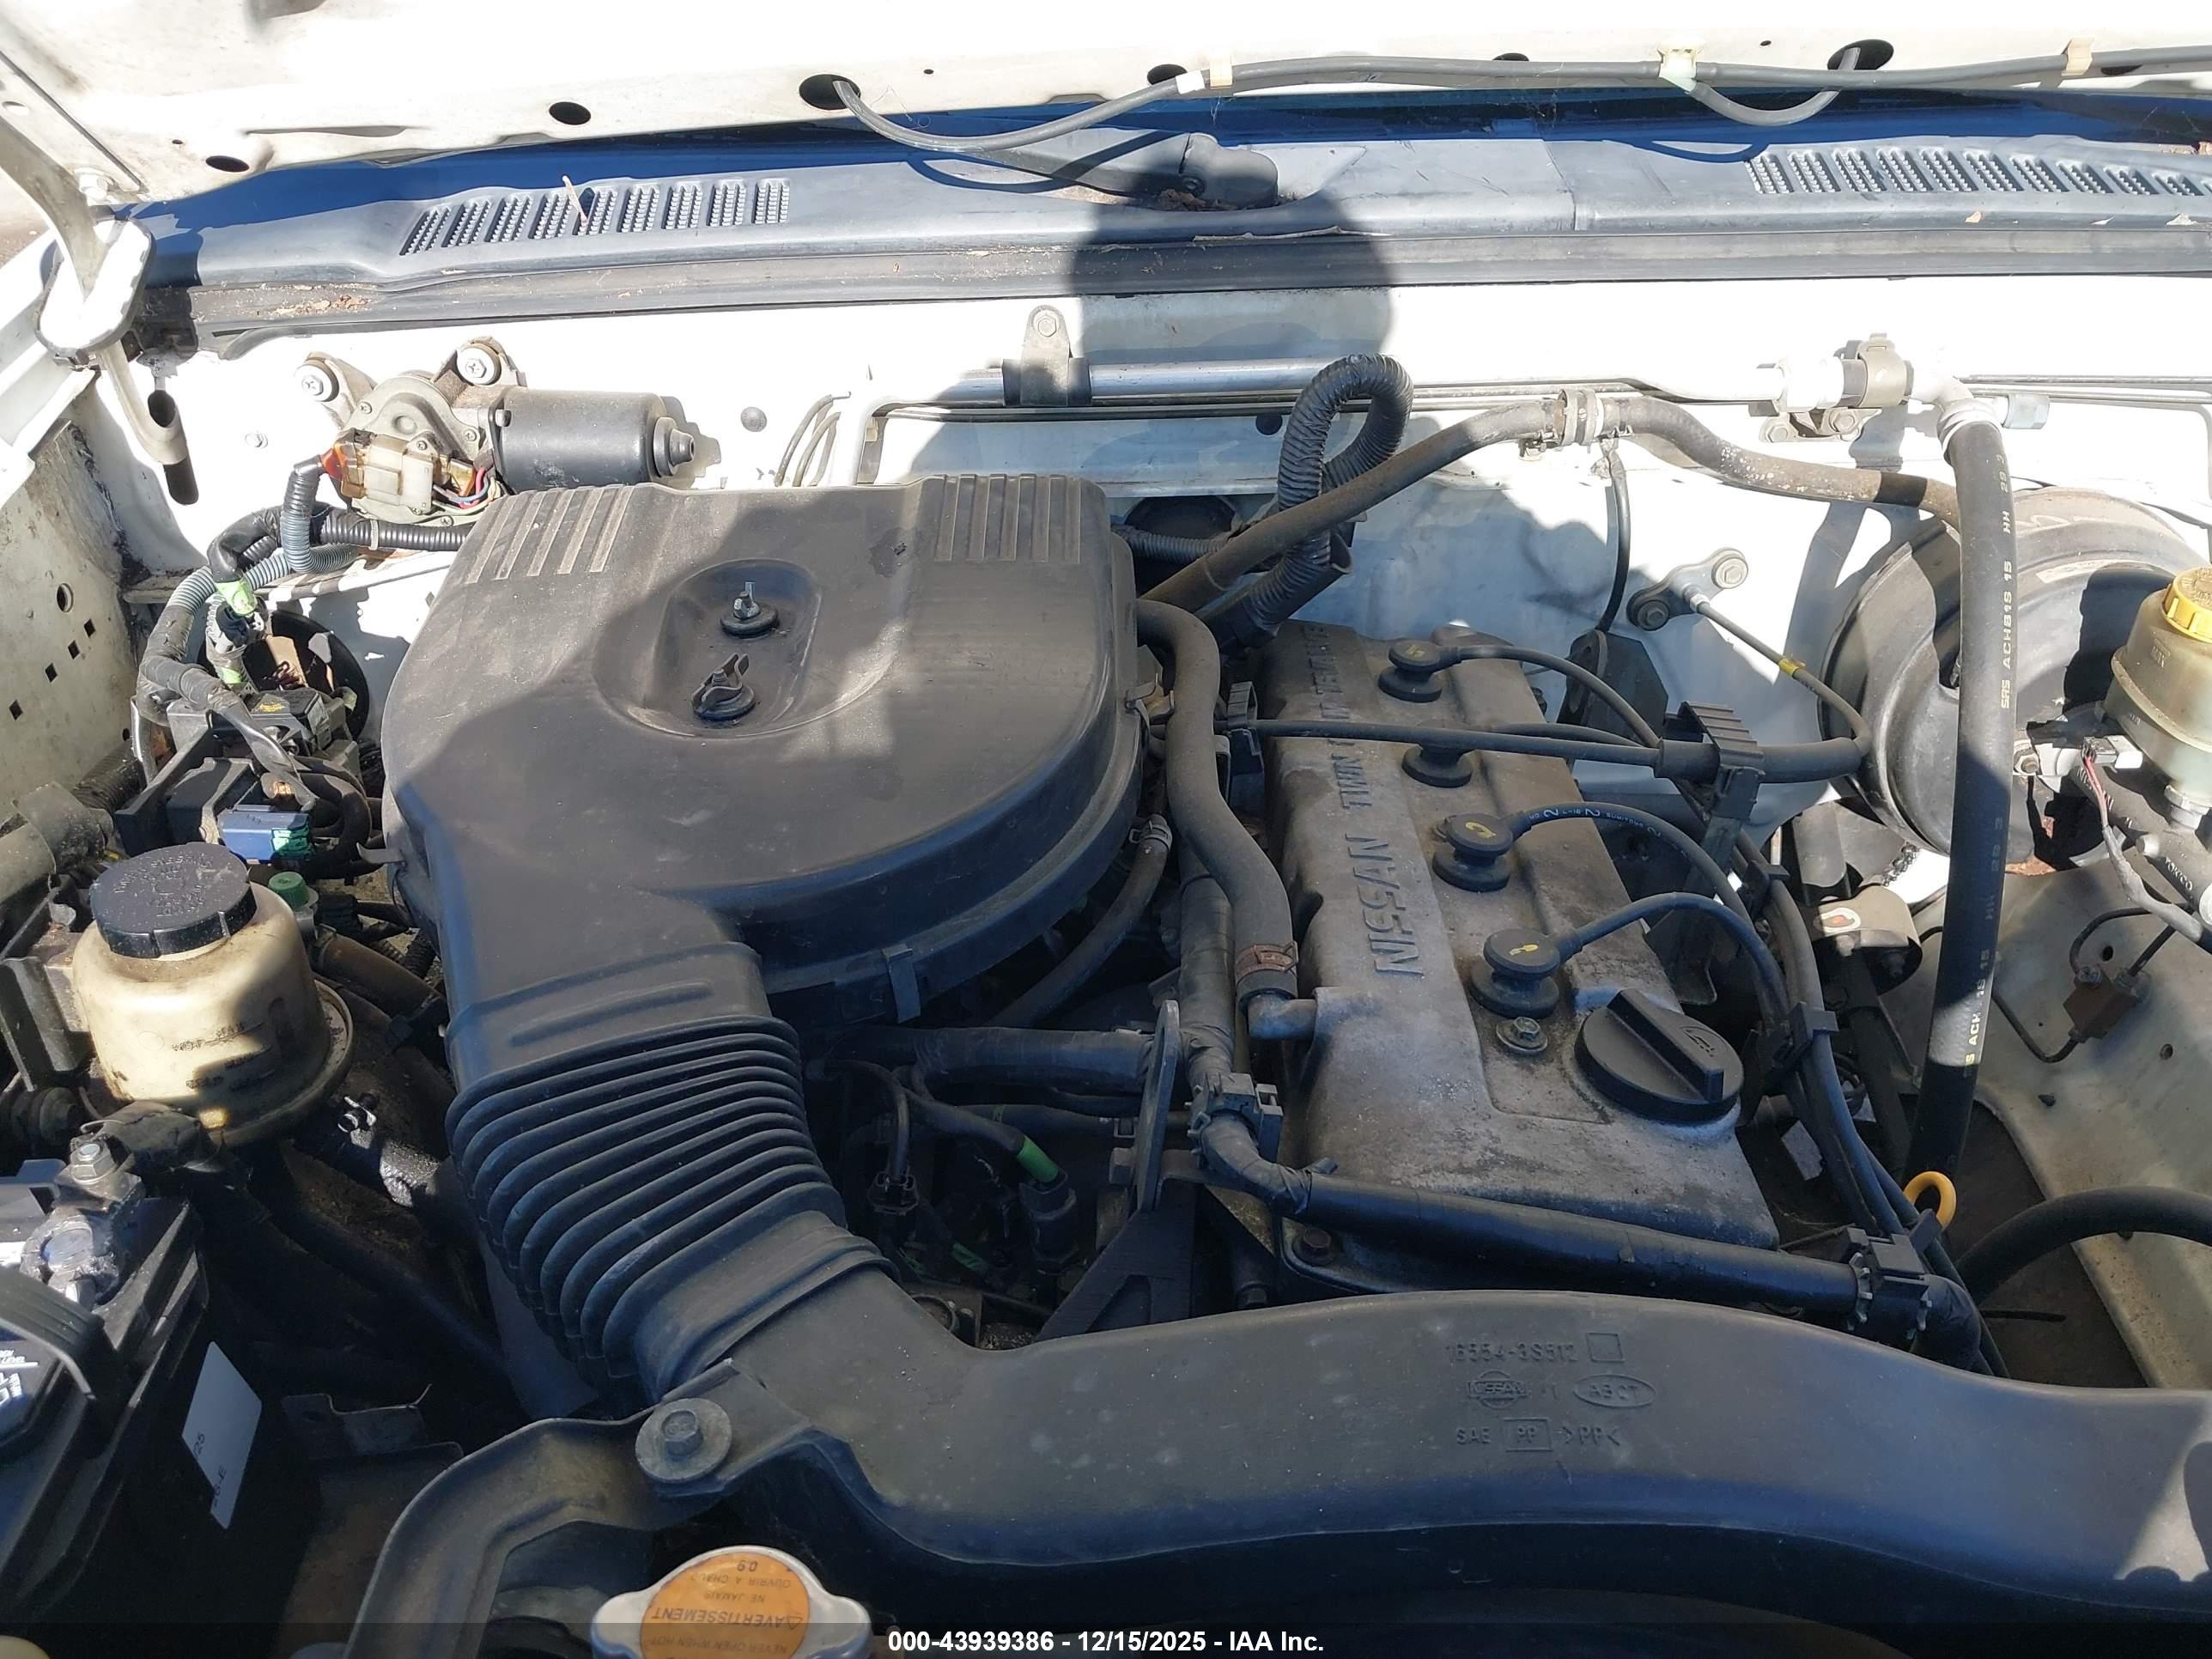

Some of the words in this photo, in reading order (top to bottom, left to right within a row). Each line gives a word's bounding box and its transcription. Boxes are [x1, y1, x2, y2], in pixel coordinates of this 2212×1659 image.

[1332, 753, 1371, 810] TWIN
[1345, 832, 1424, 976] NISSAN
[1456, 1427, 1492, 1445] SAE
[1517, 1426, 1537, 1443] PP
[737, 1559, 757, 1572] 0.9
[749, 1576, 791, 1589] OUVRIR
[703, 1589, 741, 1601] JAMAIS
[749, 1594, 765, 1603] NE
[650, 1607, 785, 1628] AVERTISSEMENT
[678, 1637, 710, 1650] WHEN
[714, 1640, 745, 1652] OPEN
[749, 1642, 787, 1654] NEVER
